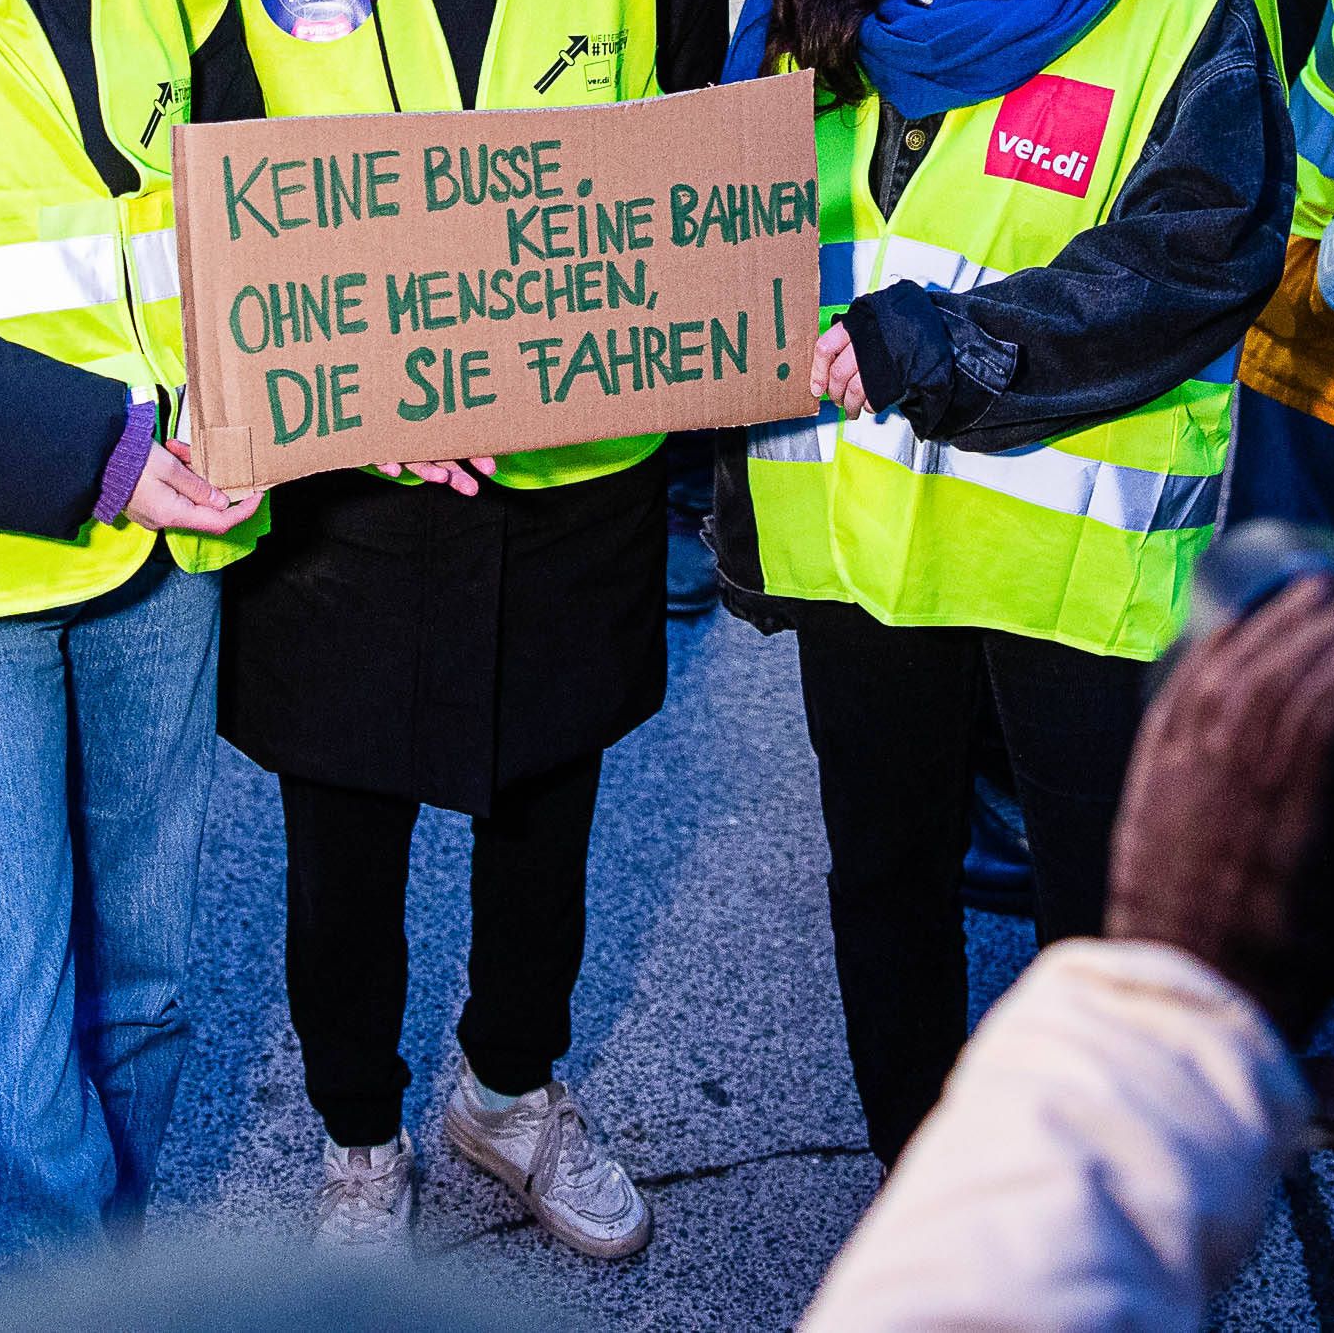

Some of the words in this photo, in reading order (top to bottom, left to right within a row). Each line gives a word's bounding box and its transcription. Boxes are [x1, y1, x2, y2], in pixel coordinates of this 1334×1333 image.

[587, 76, 610, 85] ver.di
[222, 150, 401, 242] KEINE
[998, 130, 1089, 182] ver.di
[669, 178, 817, 247] BAHNEN
[229, 272, 368, 354] OHNE
[387, 259, 658, 336] MENSCHEN,
[266, 363, 364, 447] DIE
[397, 346, 497, 422] SIE
[520, 311, 748, 405] FAHREN
